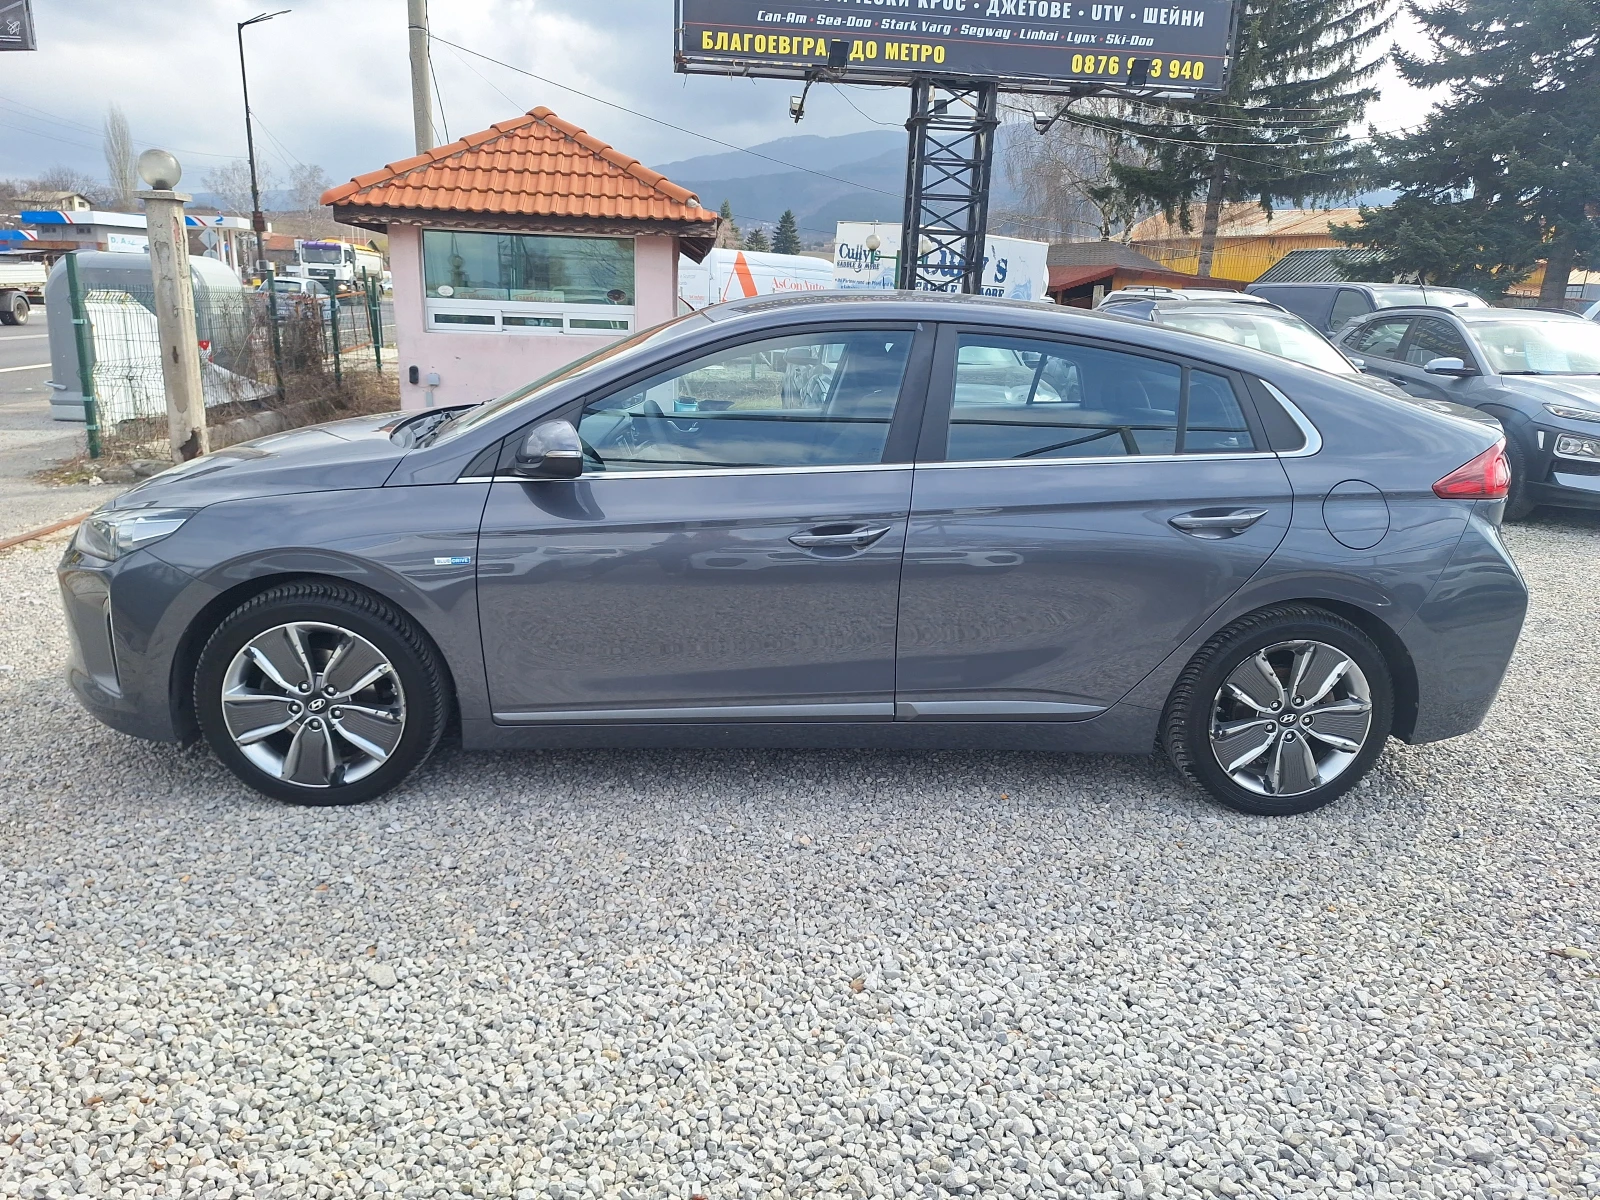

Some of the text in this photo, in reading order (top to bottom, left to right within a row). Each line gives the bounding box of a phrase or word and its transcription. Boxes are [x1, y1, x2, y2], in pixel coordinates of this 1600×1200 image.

[757, 10, 1155, 47] Can-Am Sea-Doo Stark Varg Segway Linhai Lynx Ski-Doo
[985, 0, 1071, 19] ДЖЕТОВЕ
[1091, 4, 1124, 22] UTV
[1143, 6, 1205, 28] ШЕЙНИ
[701, 30, 946, 64] БЛАГОЕВГРА ДО МЕТРО
[1071, 54, 1205, 81] 0876 93 940
